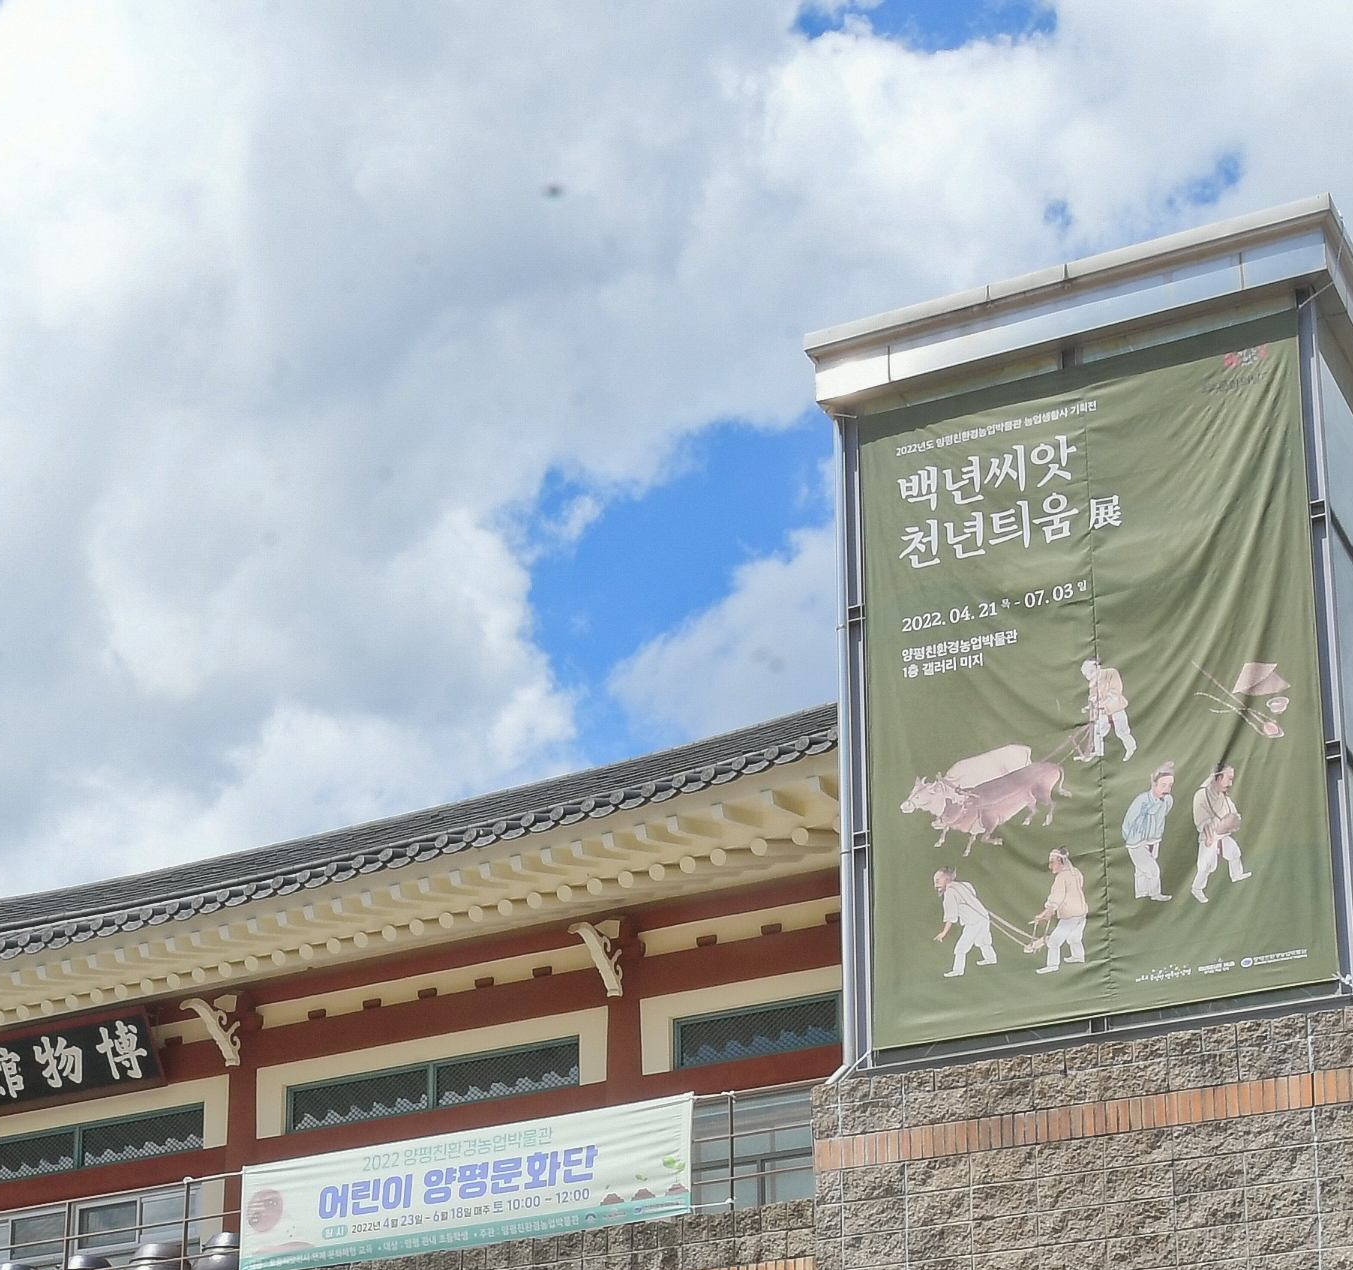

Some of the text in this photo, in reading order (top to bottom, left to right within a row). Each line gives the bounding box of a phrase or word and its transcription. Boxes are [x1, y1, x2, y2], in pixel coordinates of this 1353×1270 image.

[896, 400, 1097, 457] 2022년도 양평친환경농업박물관 농업생활사 기획전
[896, 434, 1078, 511] 백년씨앗
[898, 492, 1123, 570] 천년틔움 展
[901, 611, 946, 633] 2022.
[949, 605, 975, 624] 04.
[978, 601, 998, 618] 21
[1024, 589, 1050, 608] 07.
[1052, 582, 1074, 601] 03
[1077, 579, 1088, 593] 일
[901, 628, 1019, 663] 양평친환경농업박물관
[902, 652, 984, 679] 1층 갤러리 미지
[363, 1126, 553, 1172] 2022 양평친환경농업박물관
[318, 1144, 599, 1220] 어린이 양평문화단
[351, 1220, 381, 1234] 2022년
[383, 1217, 398, 1229] 4월
[451, 1206, 472, 1220] 18일
[474, 1204, 490, 1217] 매주
[492, 1202, 504, 1214] 토
[507, 1196, 541, 1211] 10:00
[555, 1188, 590, 1204] 12:00
[480, 1227, 494, 1238] 주관
